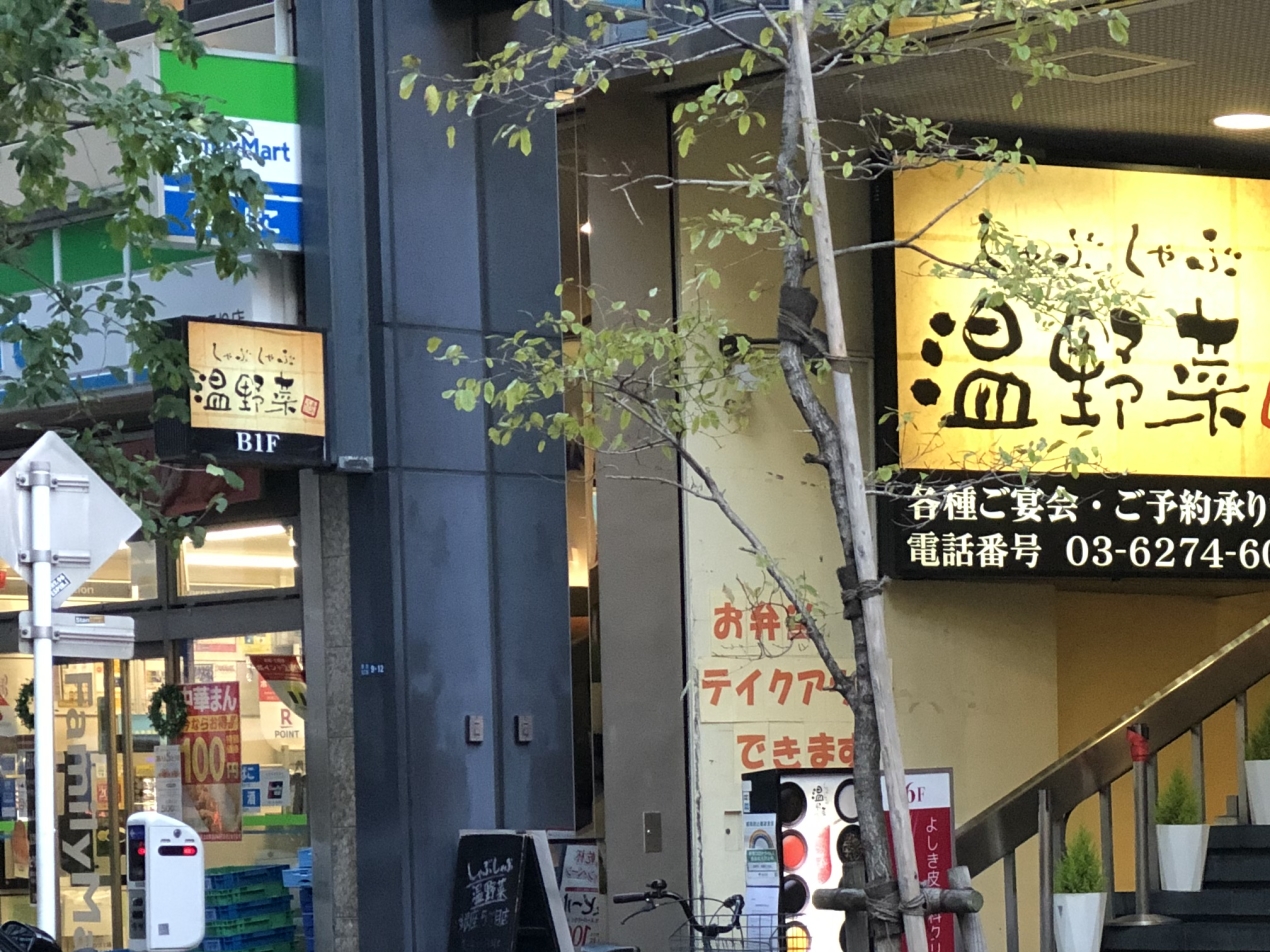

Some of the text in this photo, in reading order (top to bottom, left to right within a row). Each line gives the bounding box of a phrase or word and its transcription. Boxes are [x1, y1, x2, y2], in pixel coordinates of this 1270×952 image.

[910, 297, 1250, 437] 温野菜
[193, 368, 298, 416] 温野菜
[236, 431, 281, 453] B1F
[906, 532, 1043, 569] 電話番号
[701, 668, 852, 707] テイクア
[274, 730, 299, 739] POINT
[62, 671, 101, 950] FamilyMa
